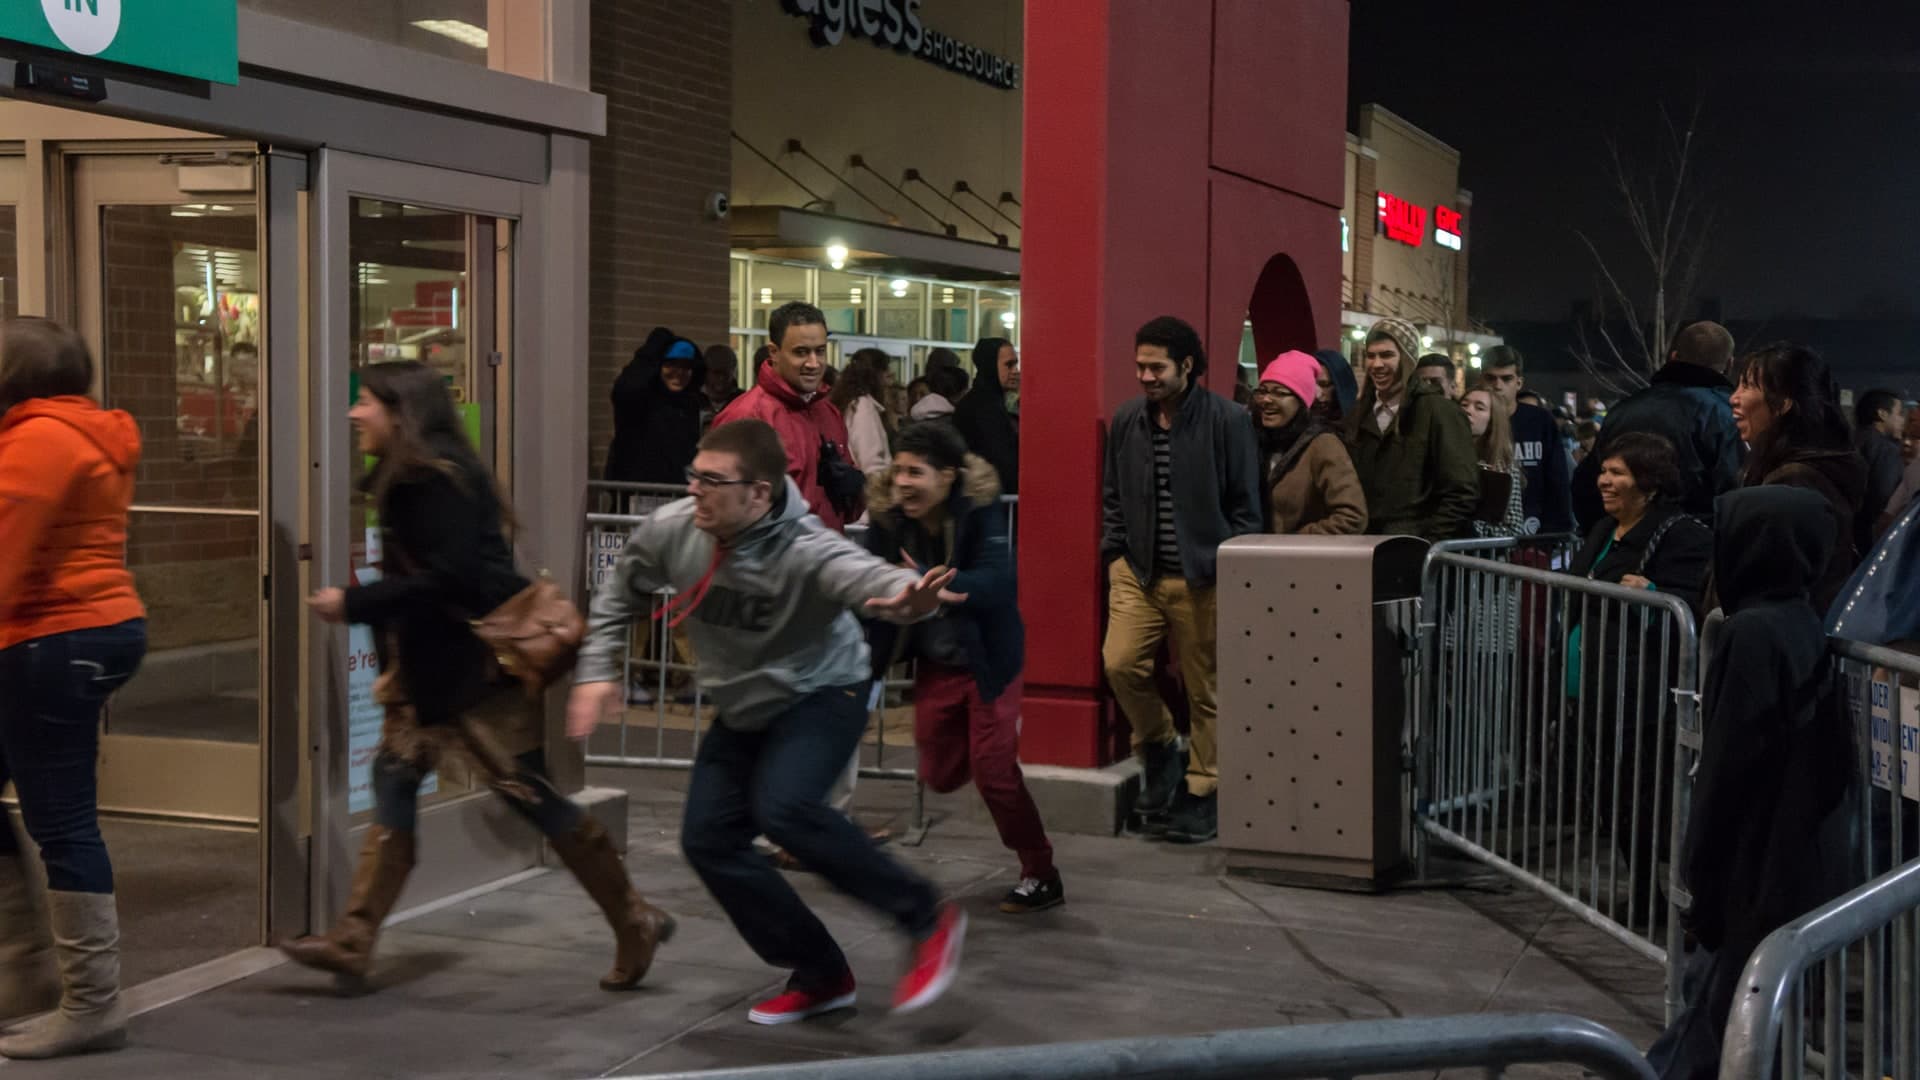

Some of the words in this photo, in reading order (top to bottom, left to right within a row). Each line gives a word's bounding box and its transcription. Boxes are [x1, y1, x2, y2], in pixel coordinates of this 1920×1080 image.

[923, 28, 1019, 89] SHOESOURCE
[1514, 440, 1543, 460] AHO
[598, 533, 630, 549] LOCK
[349, 650, 377, 672] e're
[1872, 682, 1889, 710] DER
[1902, 723, 1919, 753] ENT
